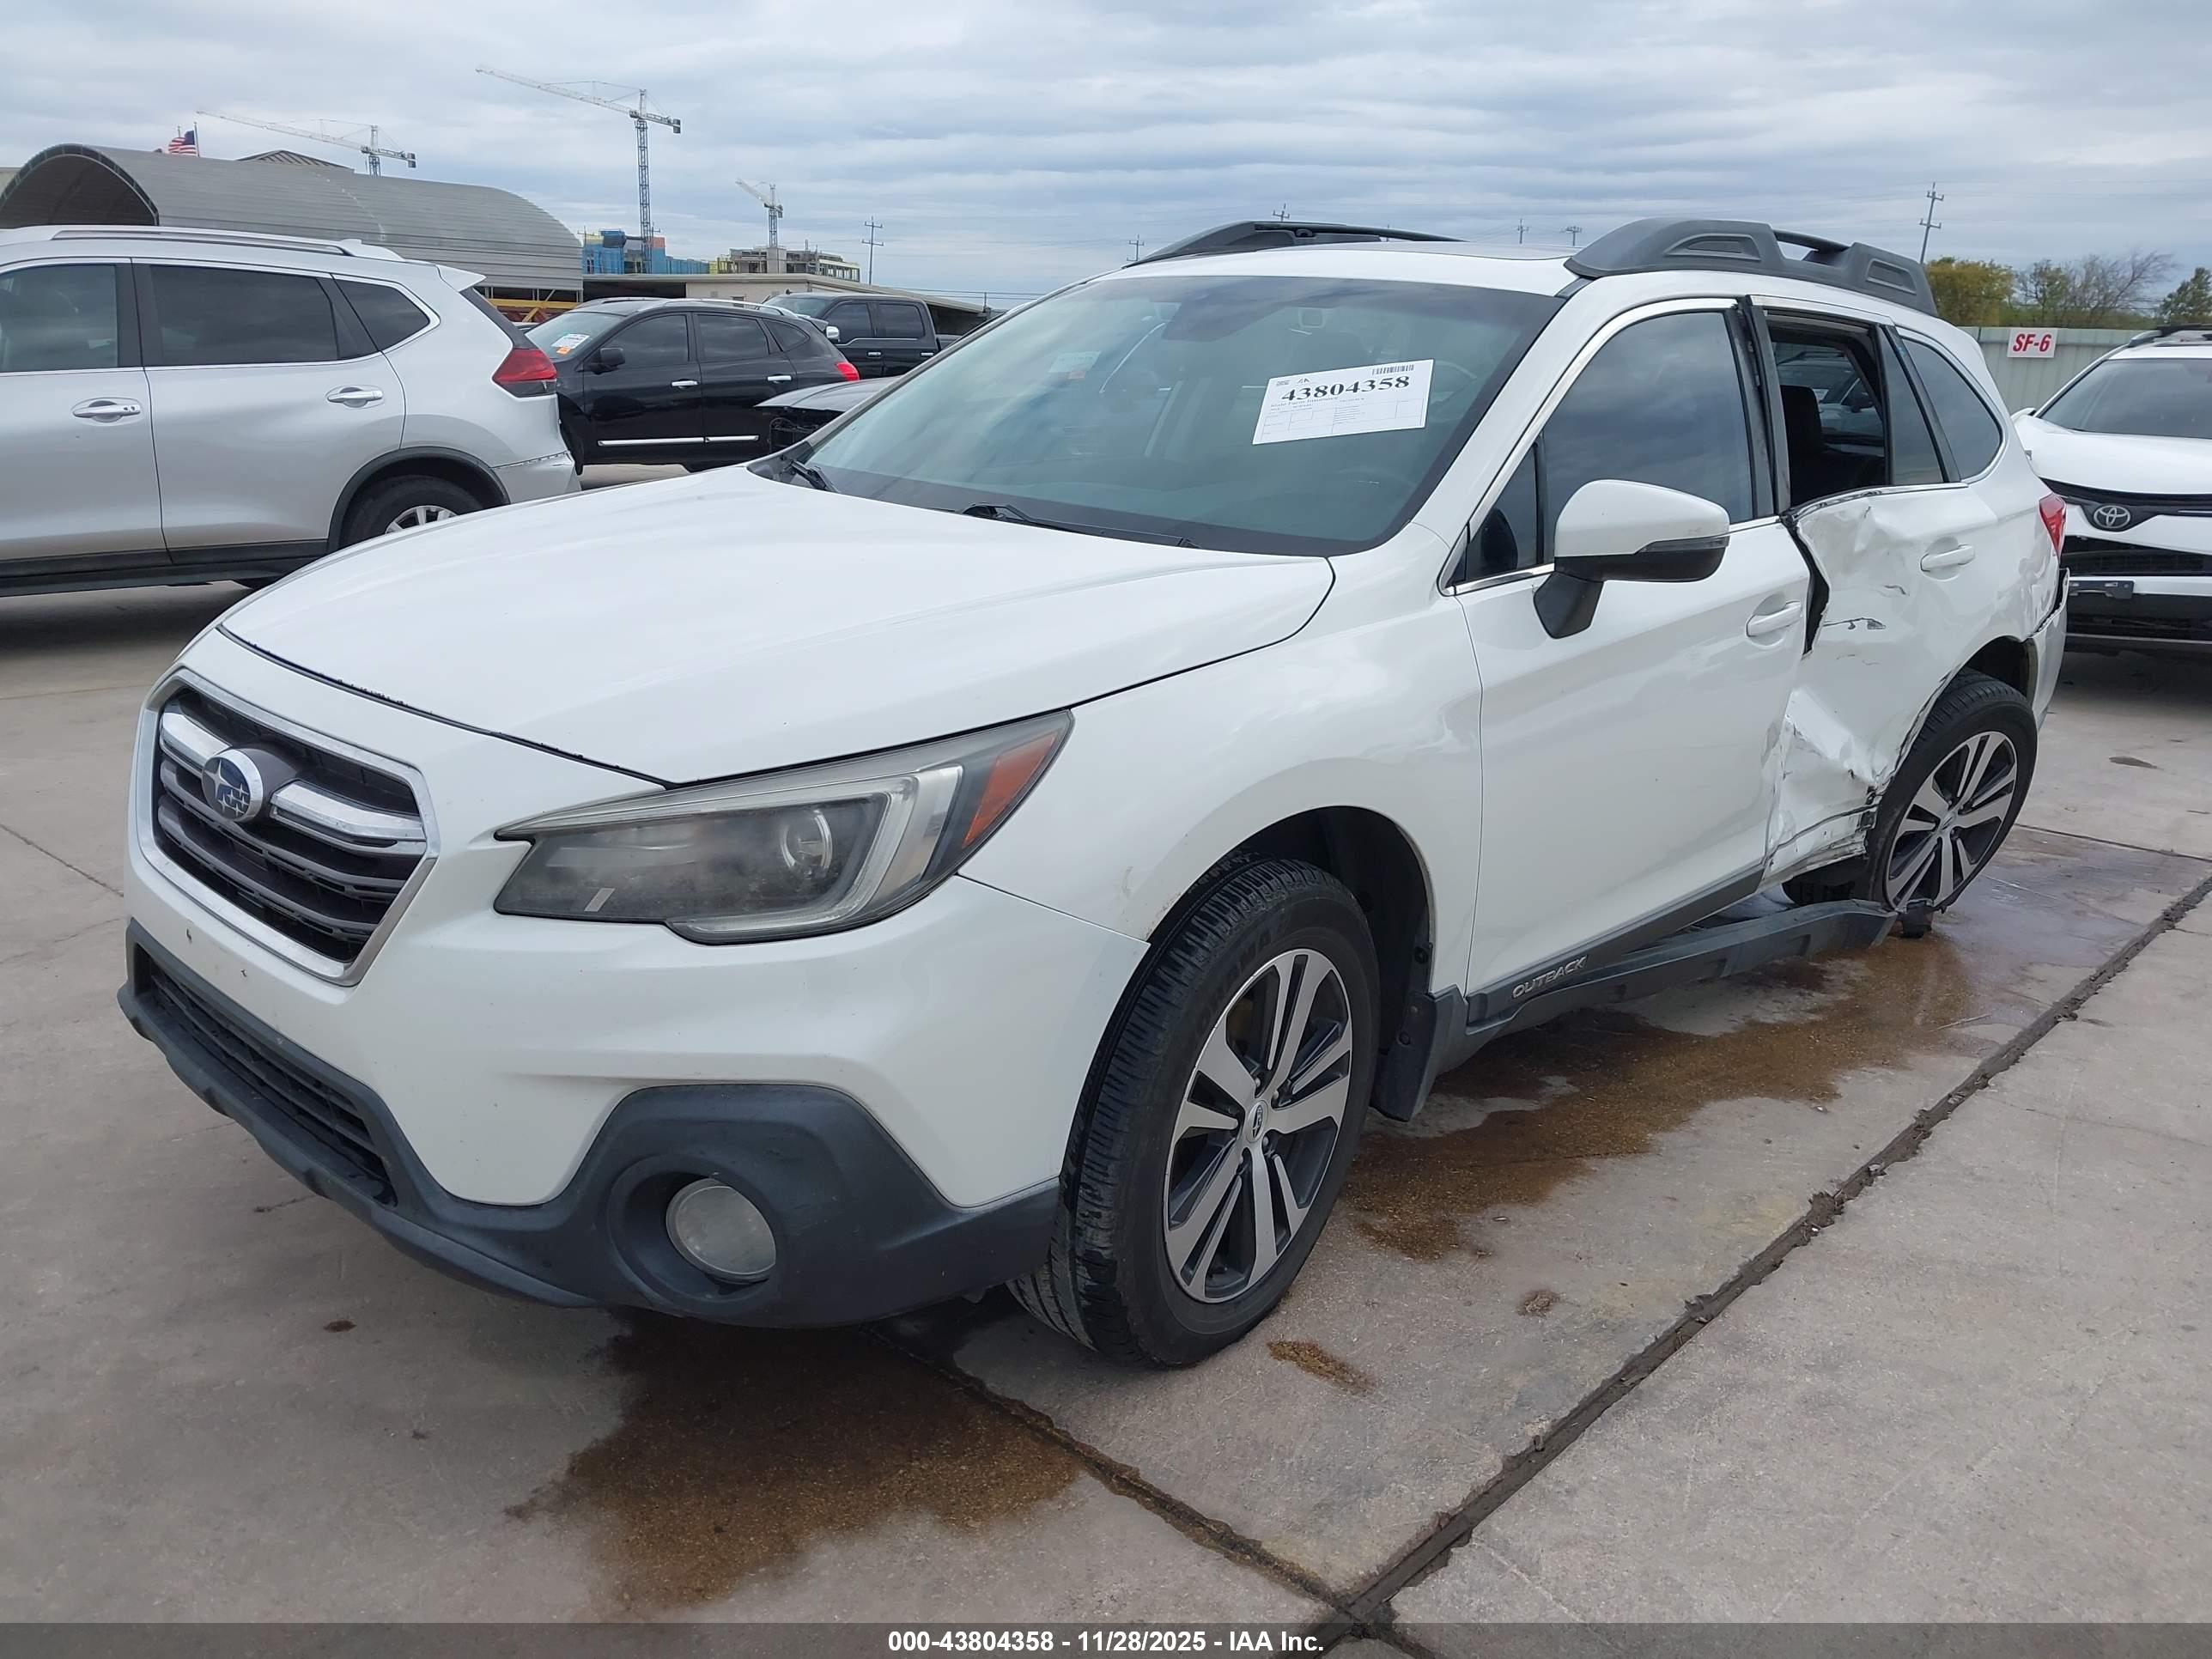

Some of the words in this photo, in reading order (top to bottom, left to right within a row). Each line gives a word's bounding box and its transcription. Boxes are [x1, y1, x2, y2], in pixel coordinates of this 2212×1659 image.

[2012, 333, 2052, 352] SF-6
[1281, 376, 1410, 401] 43804358
[1512, 954, 1588, 998] OUTBACK
